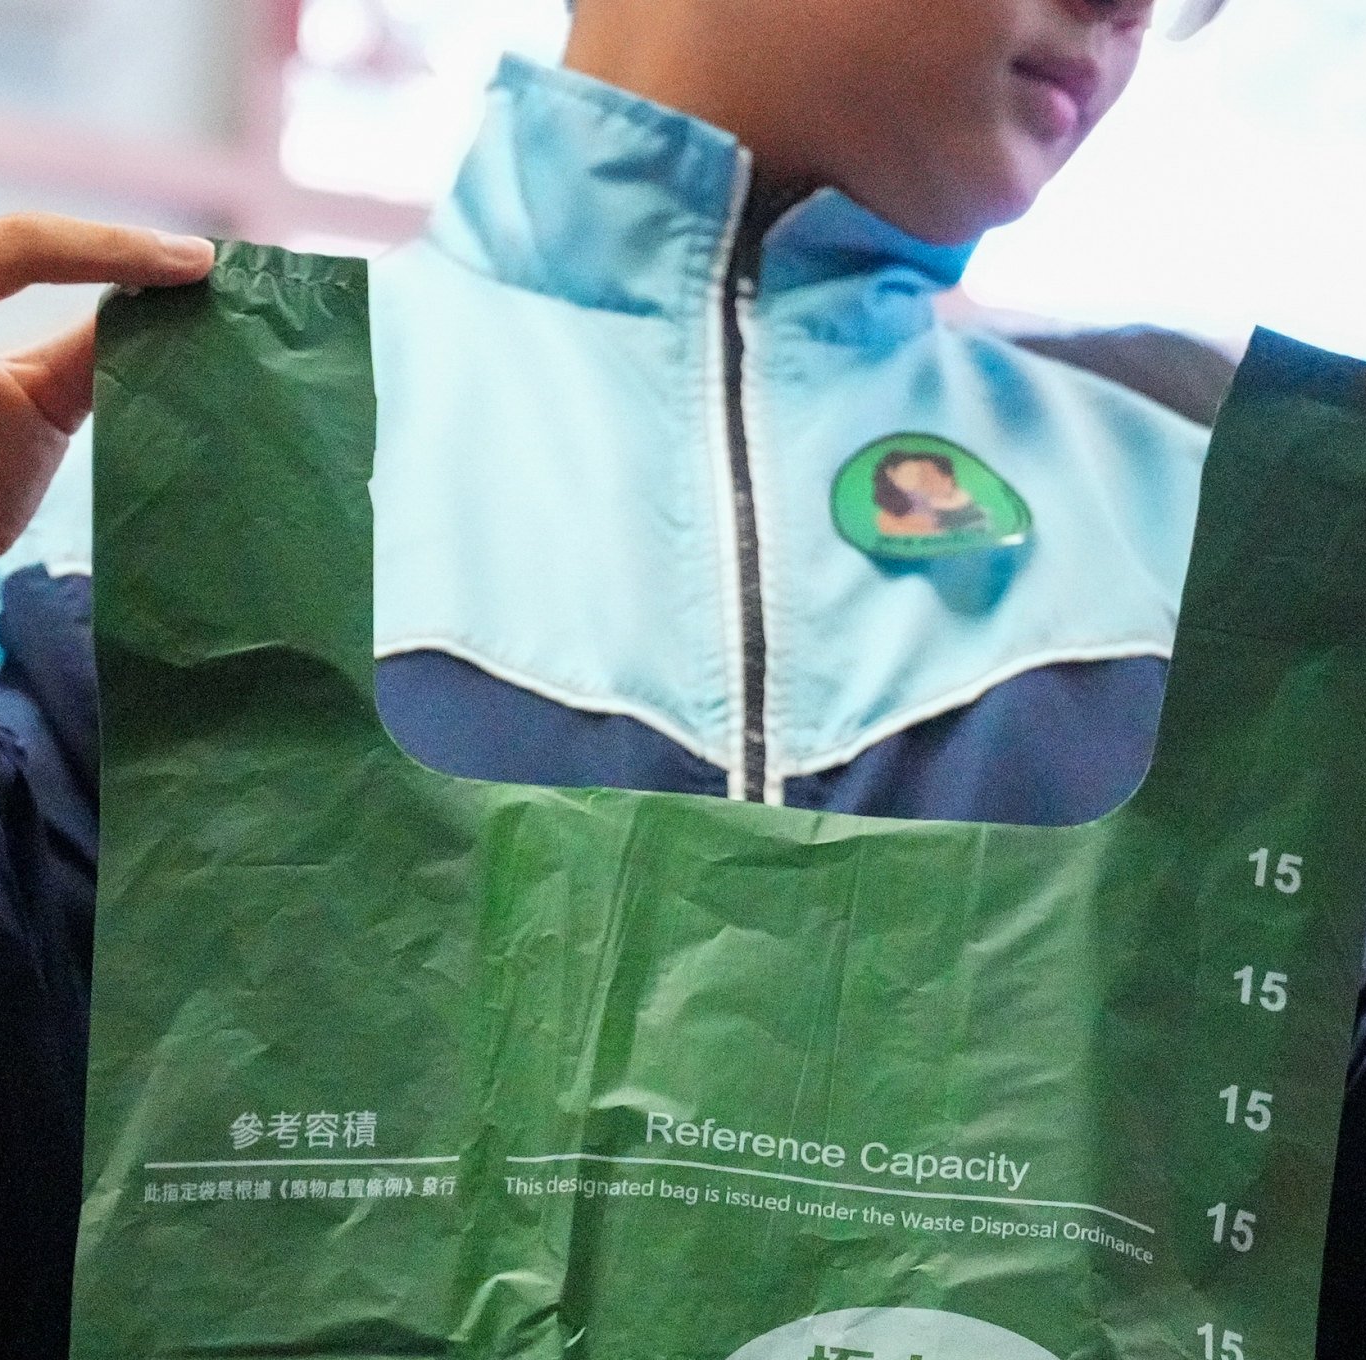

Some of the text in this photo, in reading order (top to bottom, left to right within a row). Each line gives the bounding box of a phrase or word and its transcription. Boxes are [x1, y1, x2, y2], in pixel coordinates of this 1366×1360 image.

[1249, 848, 1303, 893] 15
[1234, 966, 1288, 1012] 15
[230, 1110, 377, 1150] 參考容積
[1219, 1085, 1273, 1131] 15
[646, 1111, 1030, 1191] Reference Capacity
[504, 1176, 1154, 1264] This designated bag is issued under the Waste Disposal Ordinance
[1207, 1202, 1257, 1252] 15
